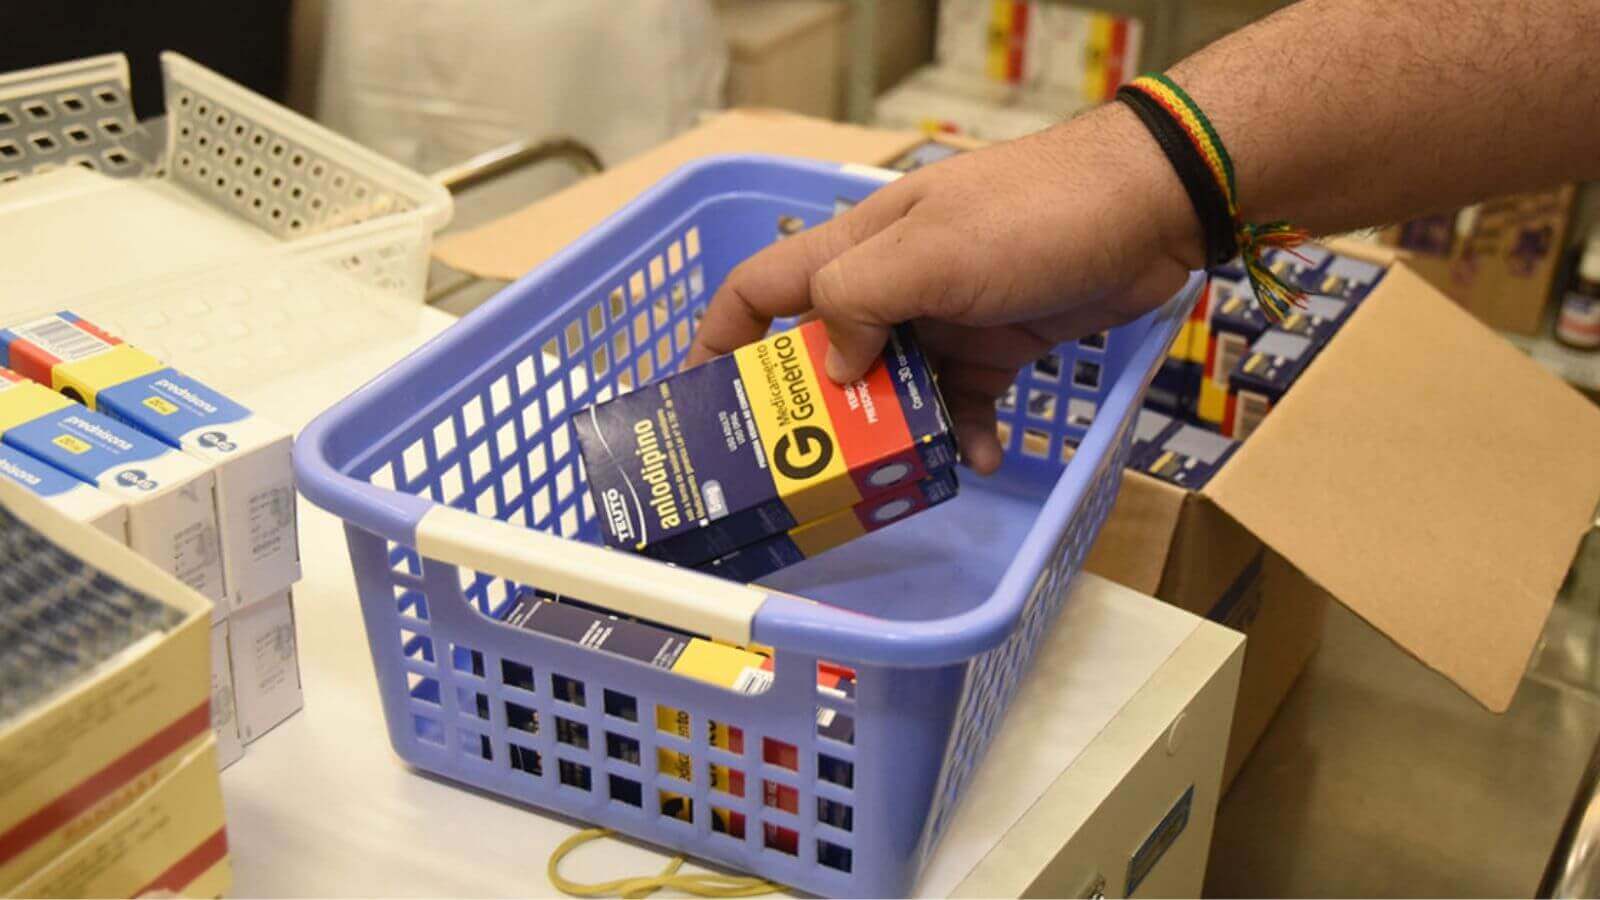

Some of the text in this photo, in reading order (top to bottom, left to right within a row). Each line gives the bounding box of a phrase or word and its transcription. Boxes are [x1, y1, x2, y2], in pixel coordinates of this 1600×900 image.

[757, 345, 790, 427] Medicamento
[774, 335, 814, 422] Genérico
[634, 418, 681, 530] anlodipino
[773, 425, 834, 480] G
[606, 489, 630, 543] TEUTO
